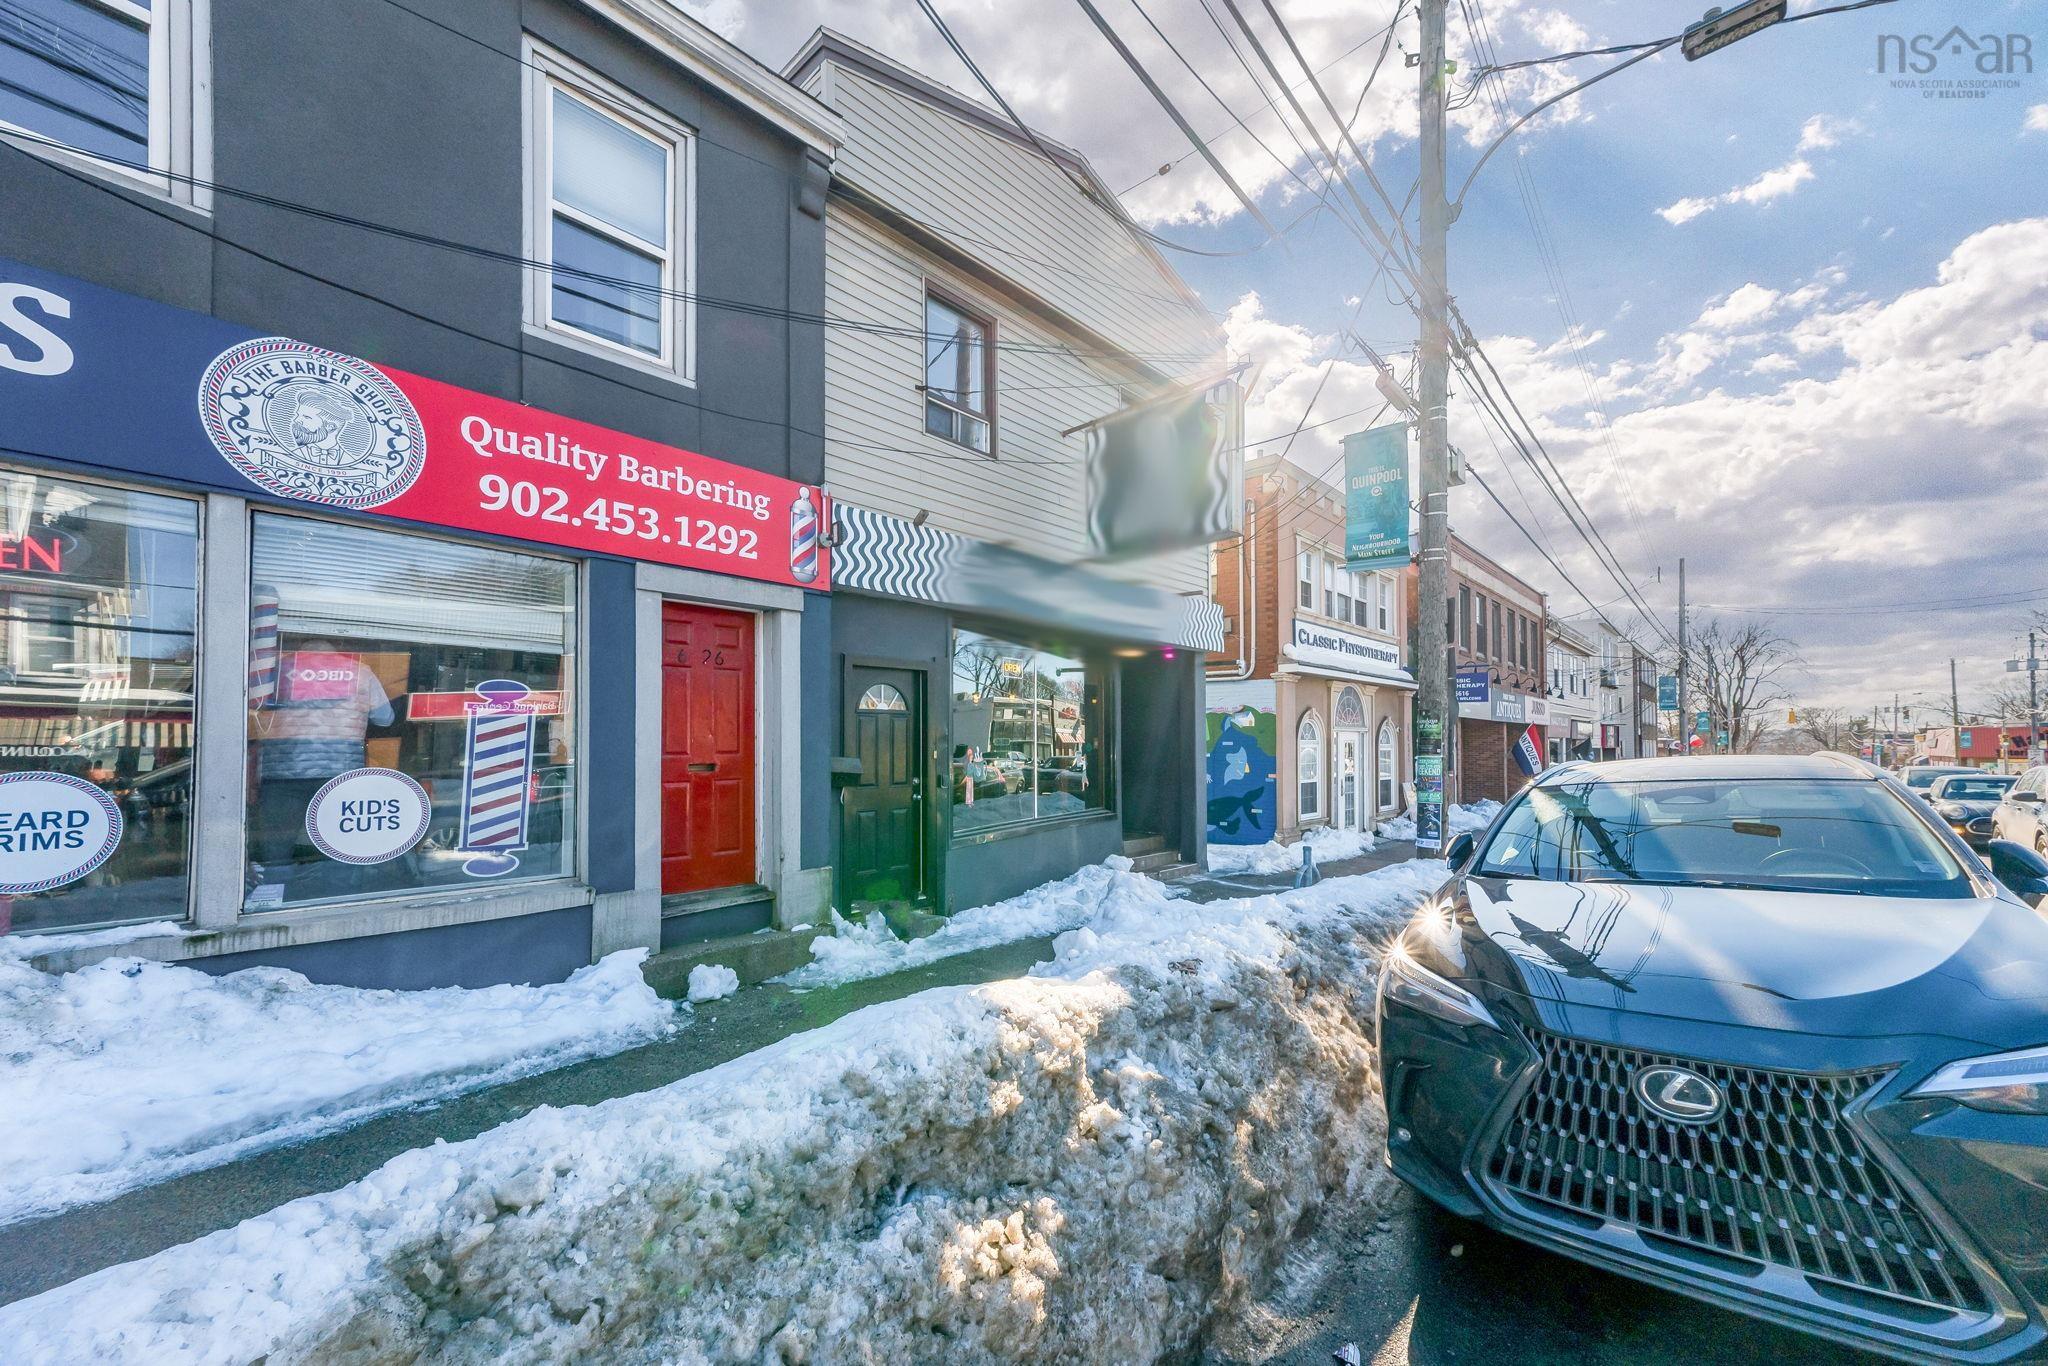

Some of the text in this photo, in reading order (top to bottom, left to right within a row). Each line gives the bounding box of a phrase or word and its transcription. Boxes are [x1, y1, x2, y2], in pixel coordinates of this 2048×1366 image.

[243, 360, 394, 416] THE BARBER SHOP
[295, 461, 347, 477] SINCE 1990
[460, 415, 771, 521] Quality Barbering
[1352, 468, 1402, 489] QUINPOOL
[479, 474, 759, 561] 902.453.1292
[1004, 662, 1020, 673] OPEN
[1496, 700, 1522, 720] ANTIQUES
[341, 799, 400, 816] KID'S
[339, 815, 400, 833] CUTS
